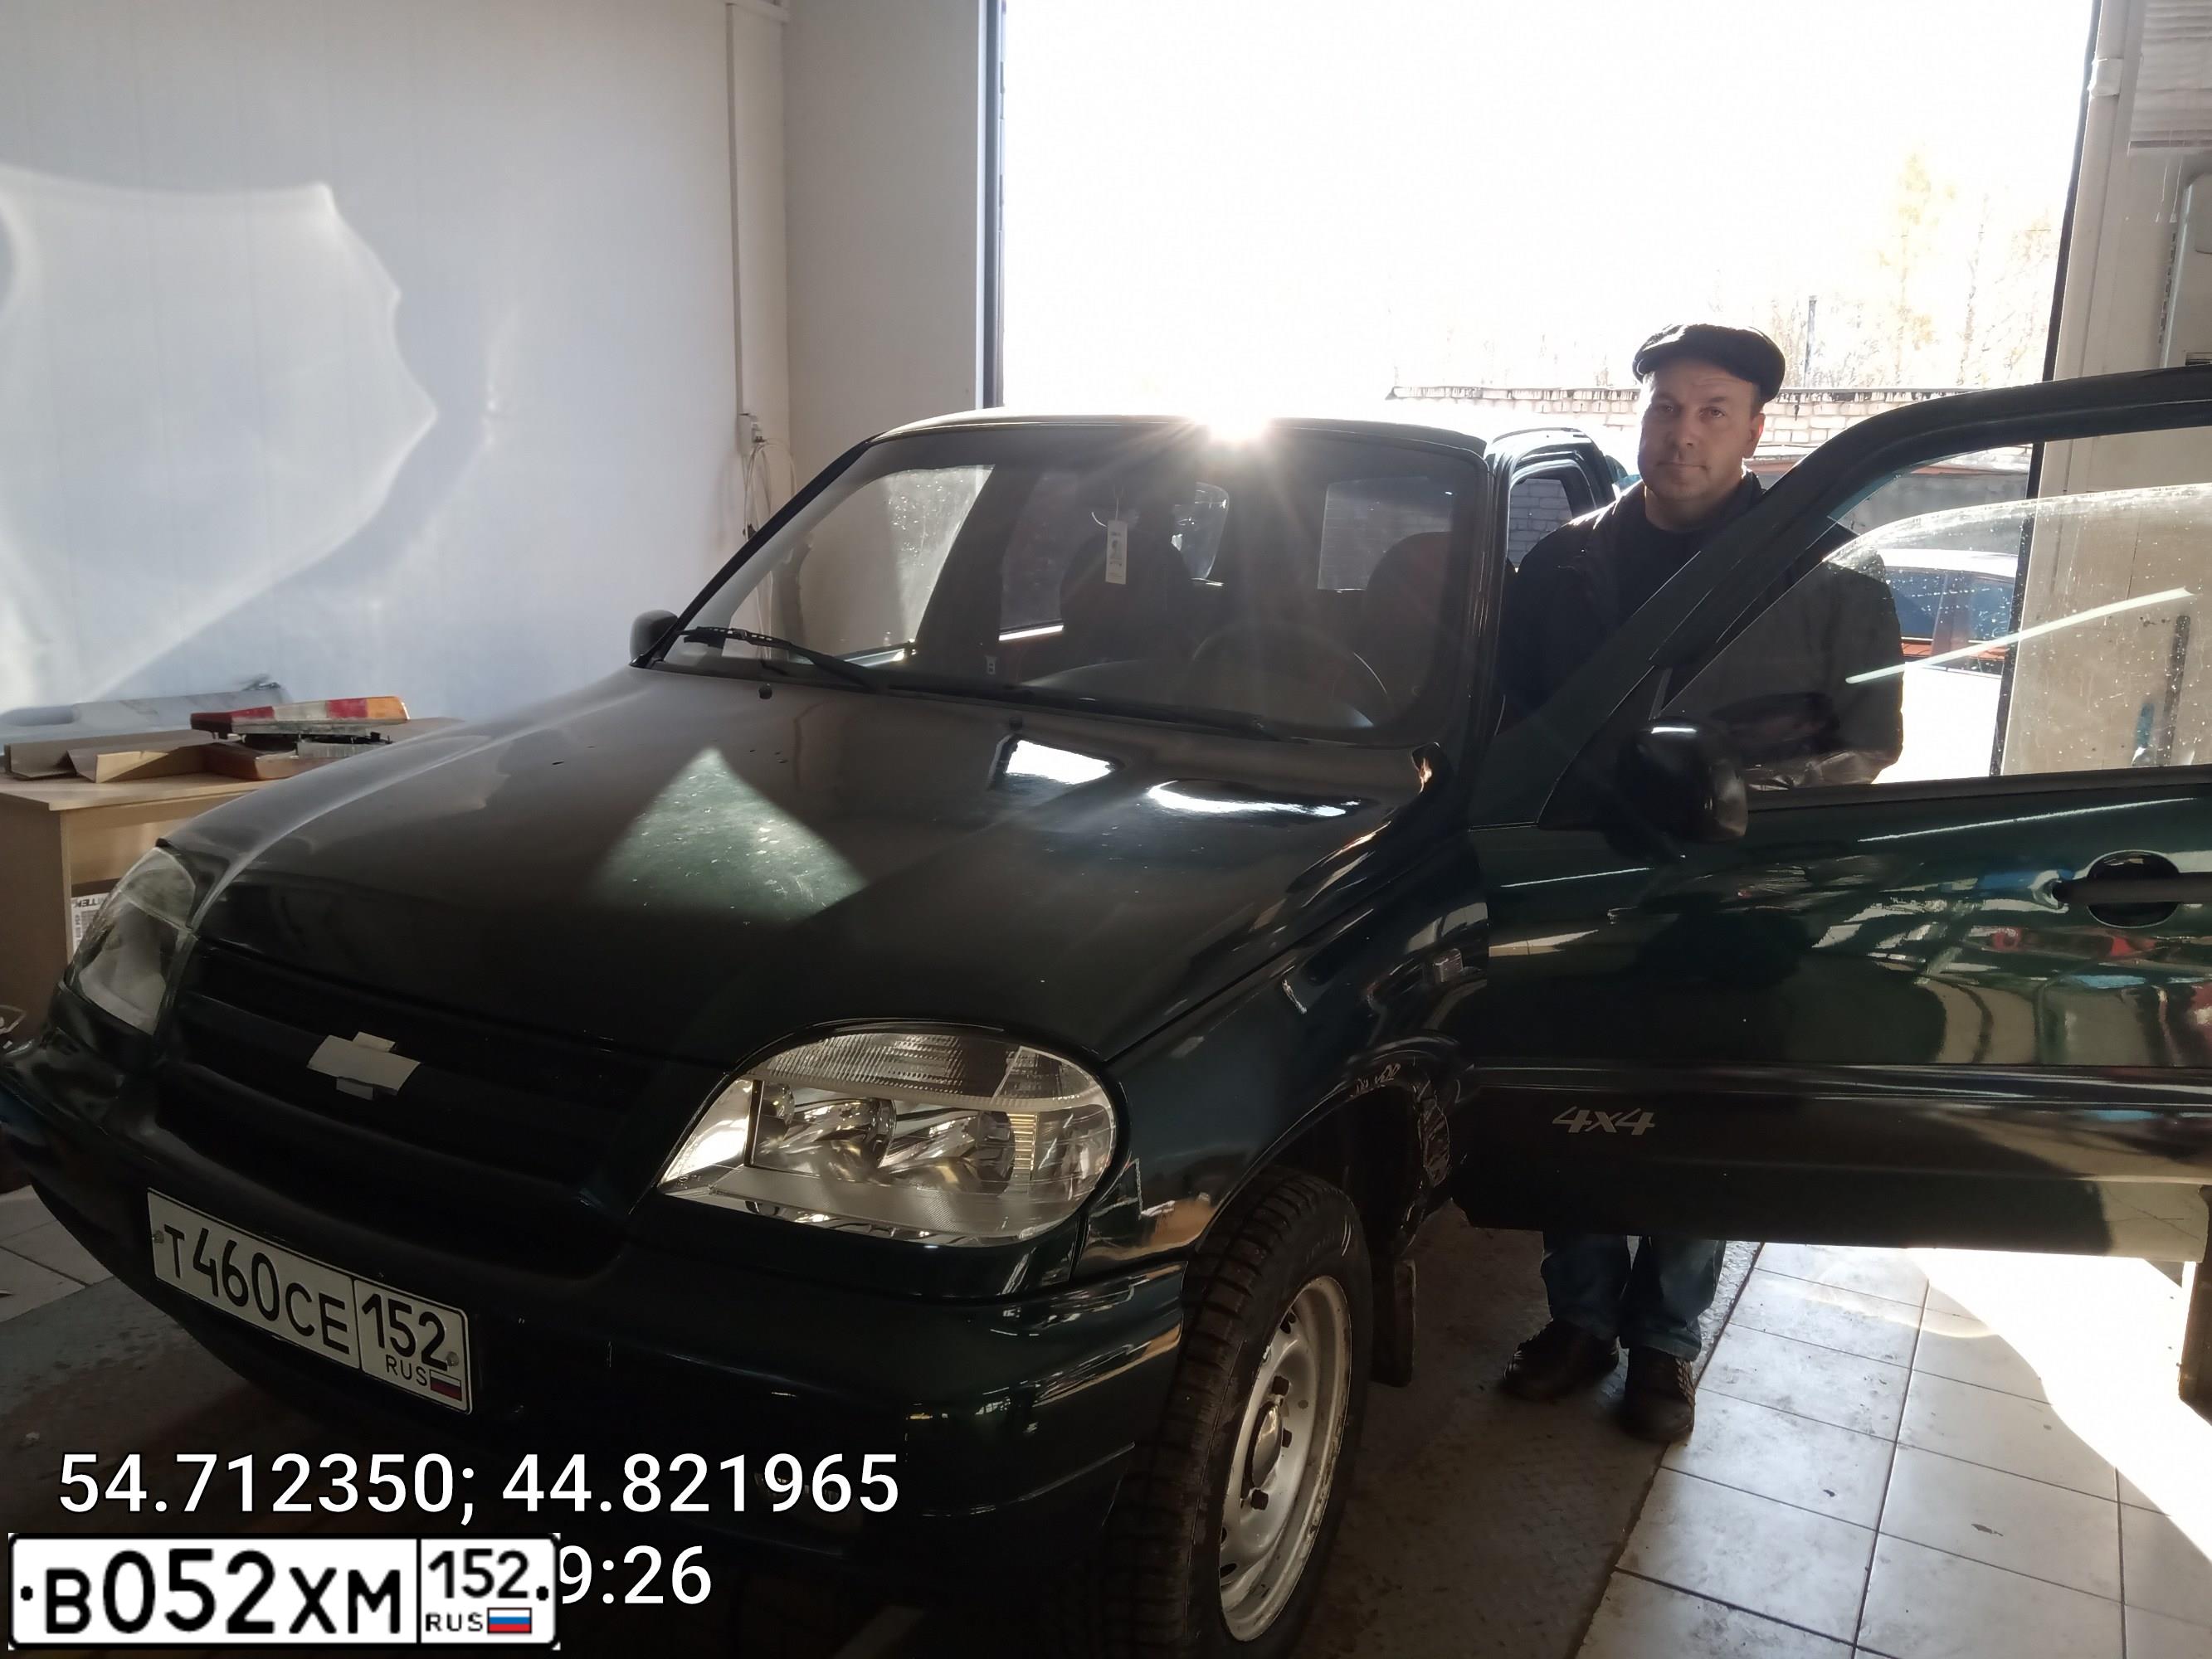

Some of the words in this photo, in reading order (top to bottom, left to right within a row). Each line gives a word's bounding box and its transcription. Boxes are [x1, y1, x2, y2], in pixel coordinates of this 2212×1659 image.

[1552, 1106, 1656, 1136] 4x4
[163, 1224, 351, 1356] Т460СЕ
[361, 1292, 449, 1373] 152
[385, 1353, 429, 1388] RUS
